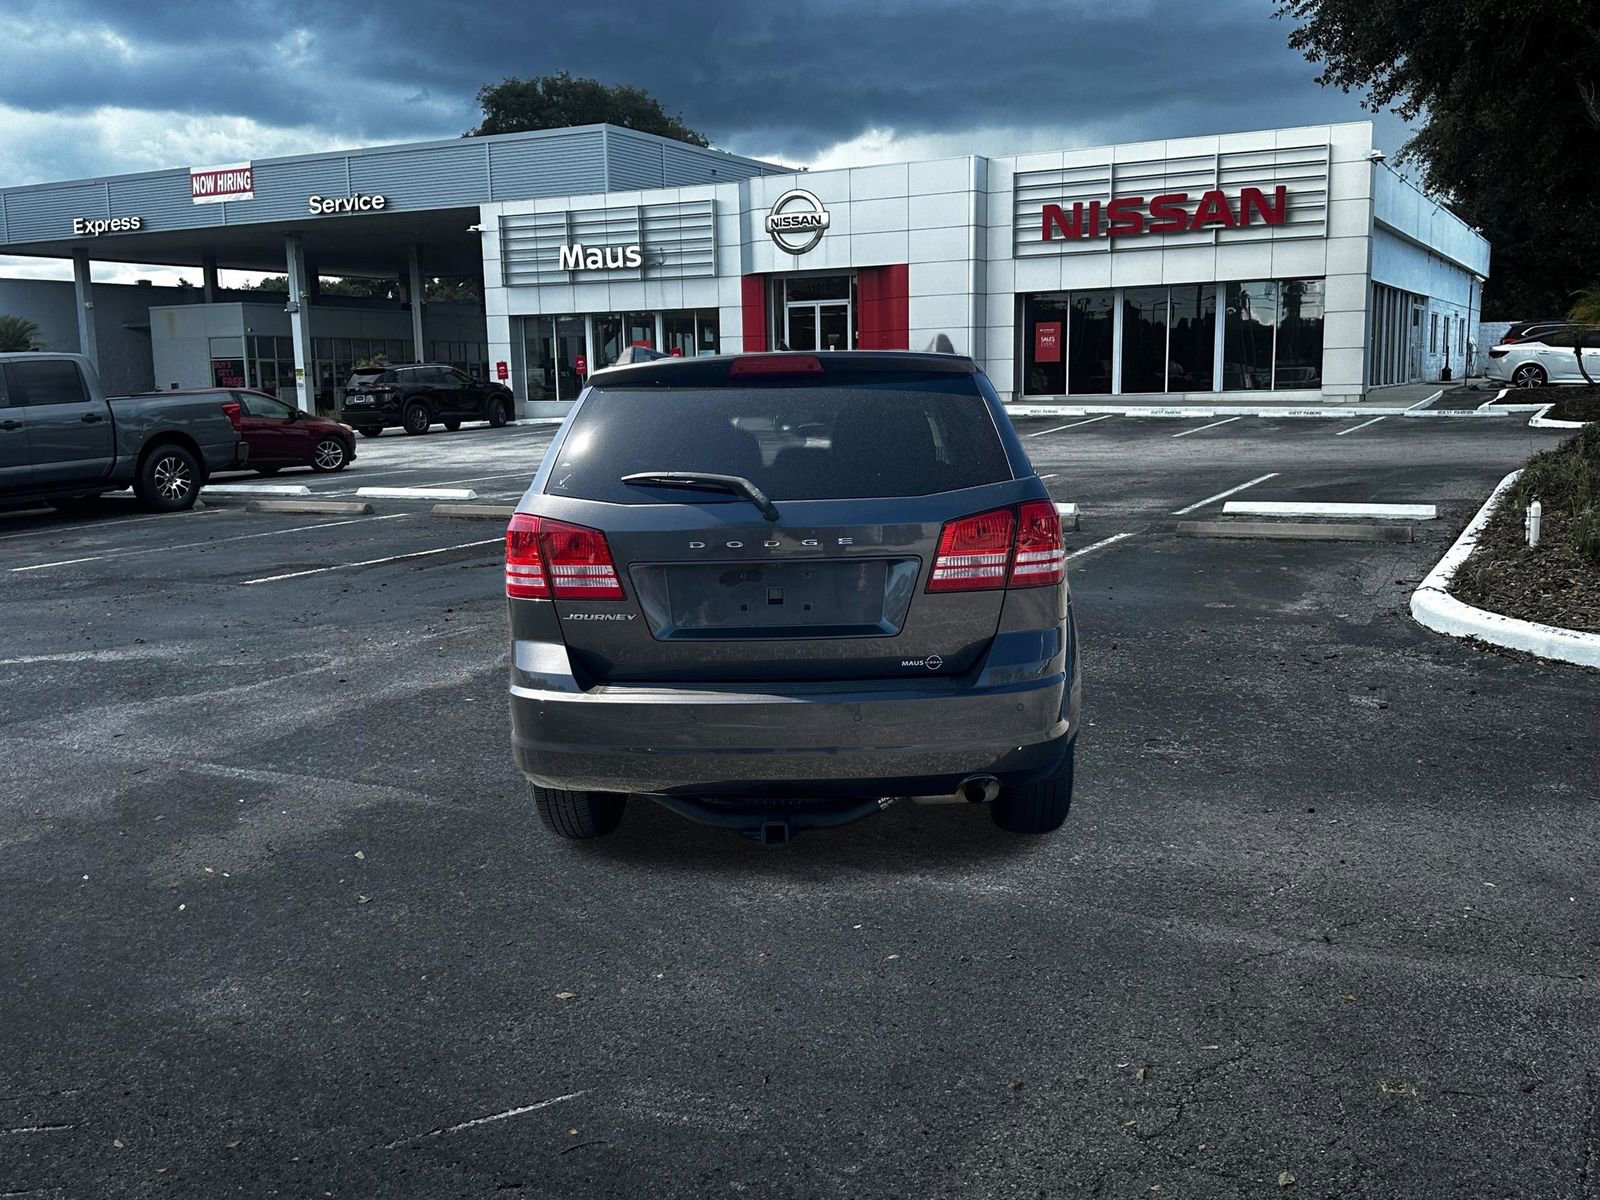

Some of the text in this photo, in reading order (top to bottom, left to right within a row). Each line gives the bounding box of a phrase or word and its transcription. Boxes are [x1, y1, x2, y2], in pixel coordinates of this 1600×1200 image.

[192, 171, 251, 195] NOW HIRING
[308, 192, 385, 215] Service
[1041, 185, 1287, 241] NISSAN
[73, 216, 141, 237] Express
[770, 215, 822, 229] NISSAN
[559, 243, 642, 270] Maus
[222, 377, 245, 387] FREE
[689, 537, 853, 549] DODGE
[562, 613, 637, 621] JOURNEY
